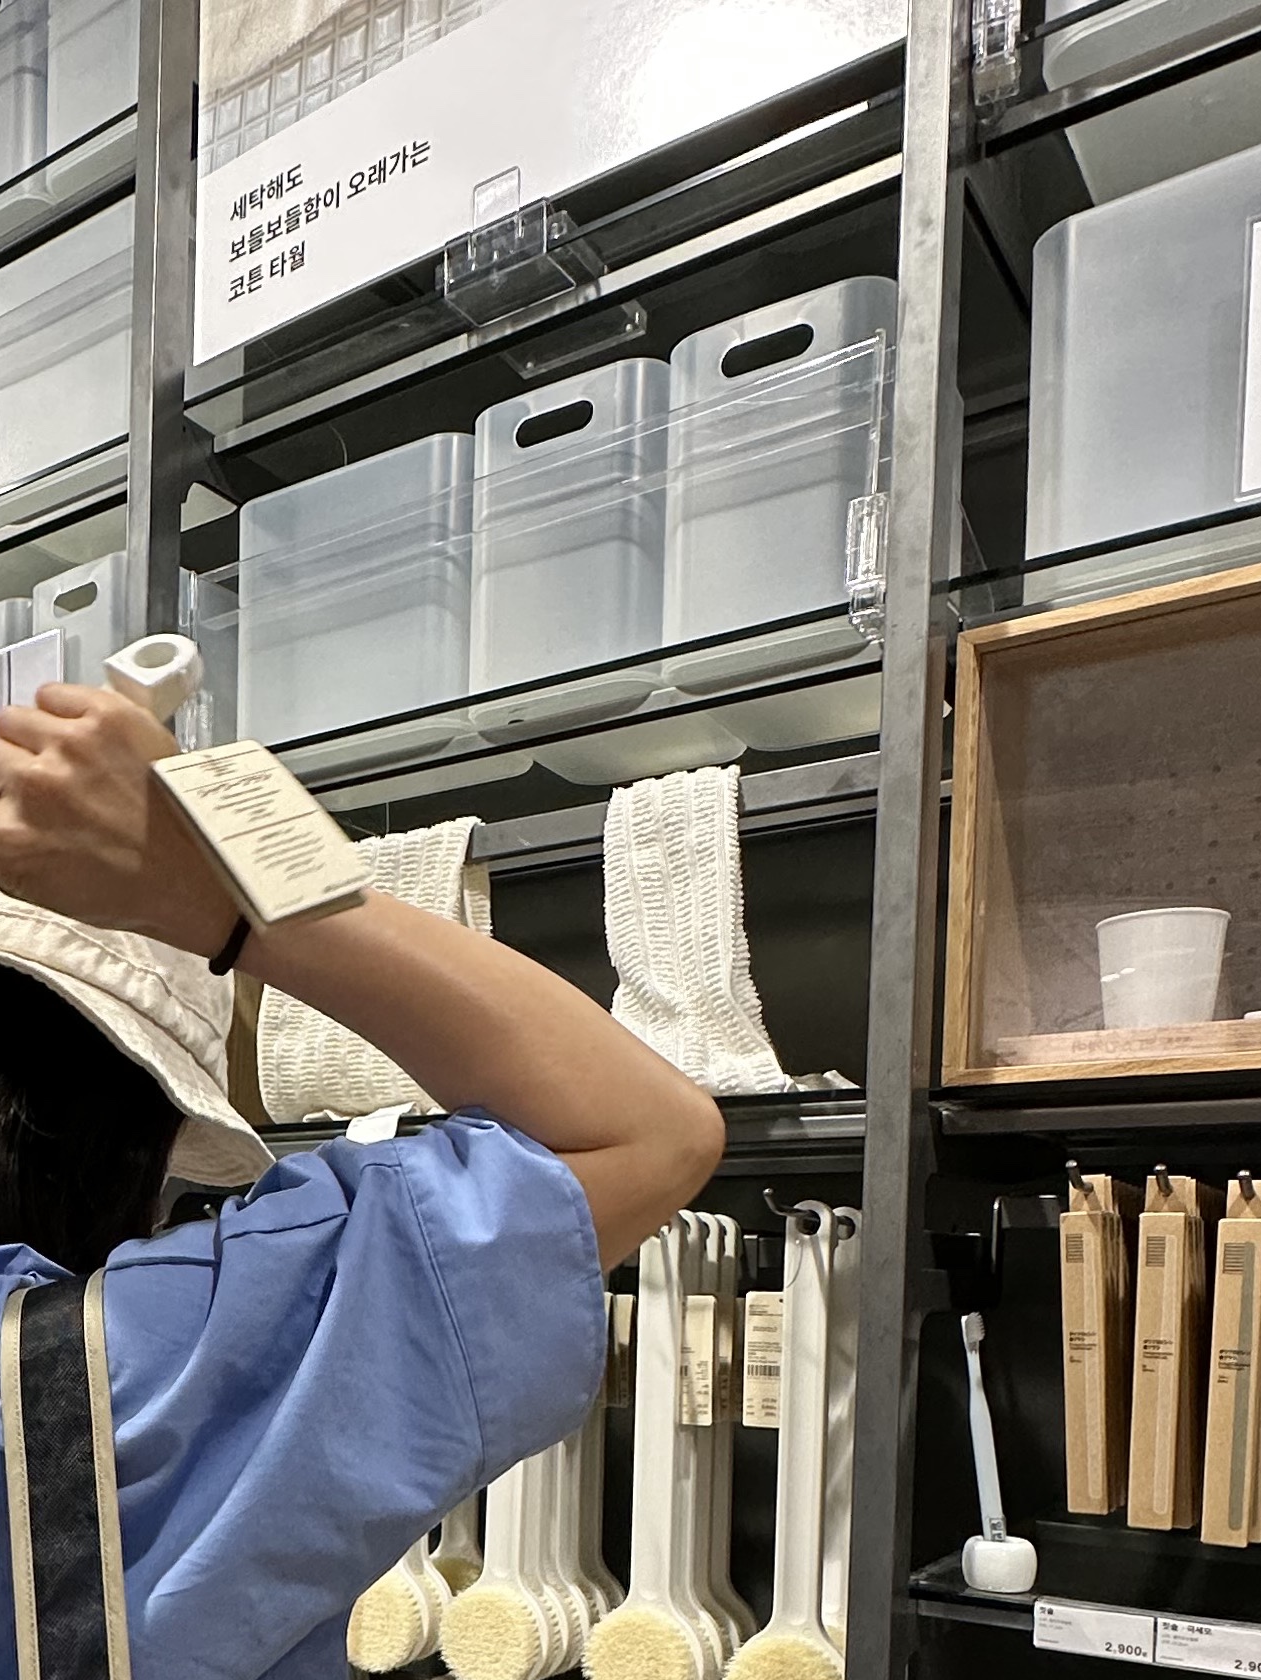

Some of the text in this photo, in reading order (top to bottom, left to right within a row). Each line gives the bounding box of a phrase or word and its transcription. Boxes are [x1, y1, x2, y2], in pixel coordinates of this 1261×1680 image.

[228, 140, 432, 263] 보들보들함이 오래가는
[229, 163, 304, 222] 세탁해도
[227, 241, 307, 302] 코튼 타월
